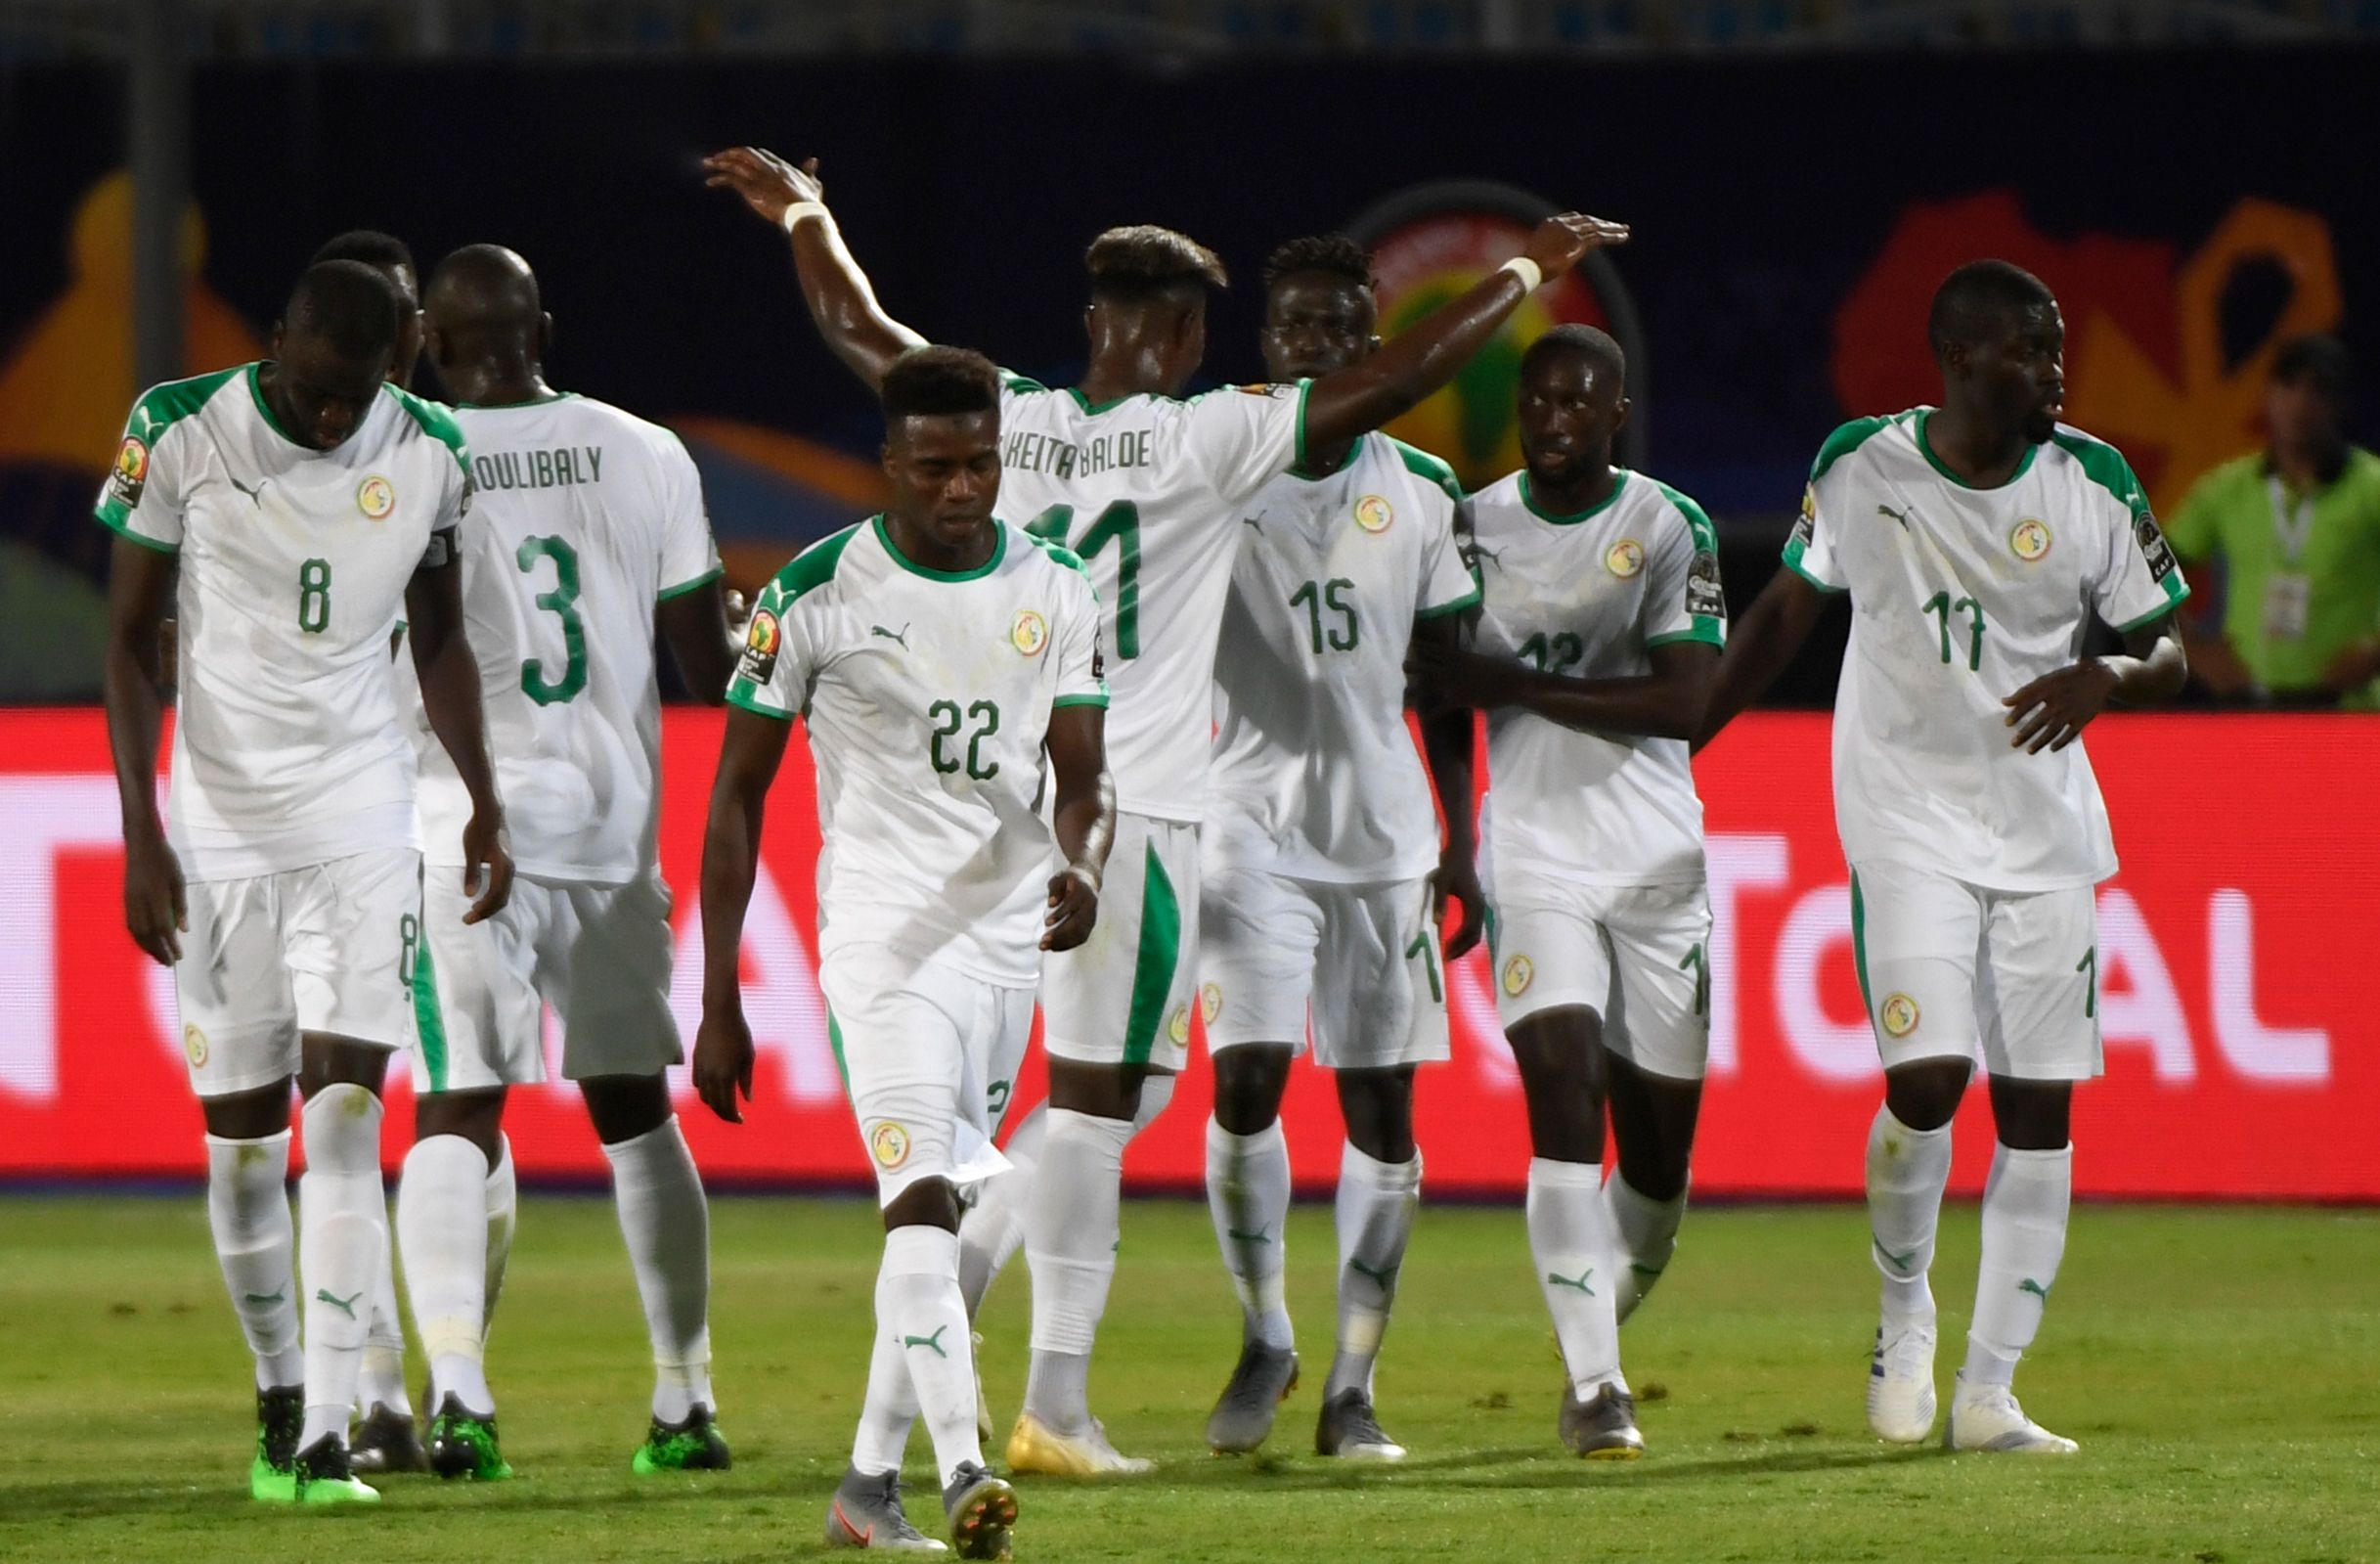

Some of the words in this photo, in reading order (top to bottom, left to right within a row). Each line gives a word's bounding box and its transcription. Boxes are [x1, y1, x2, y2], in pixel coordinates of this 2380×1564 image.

[472, 446, 601, 492] OULIBALY
[1004, 431, 1078, 480] KEITA
[1080, 429, 1152, 479] BALDE
[299, 558, 331, 634] 8
[516, 534, 587, 706] 3
[1290, 578, 1358, 654] 15
[1922, 591, 1986, 672] 17
[929, 699, 999, 781] 22
[399, 913, 418, 987] 8
[1679, 943, 1710, 1015] 1
